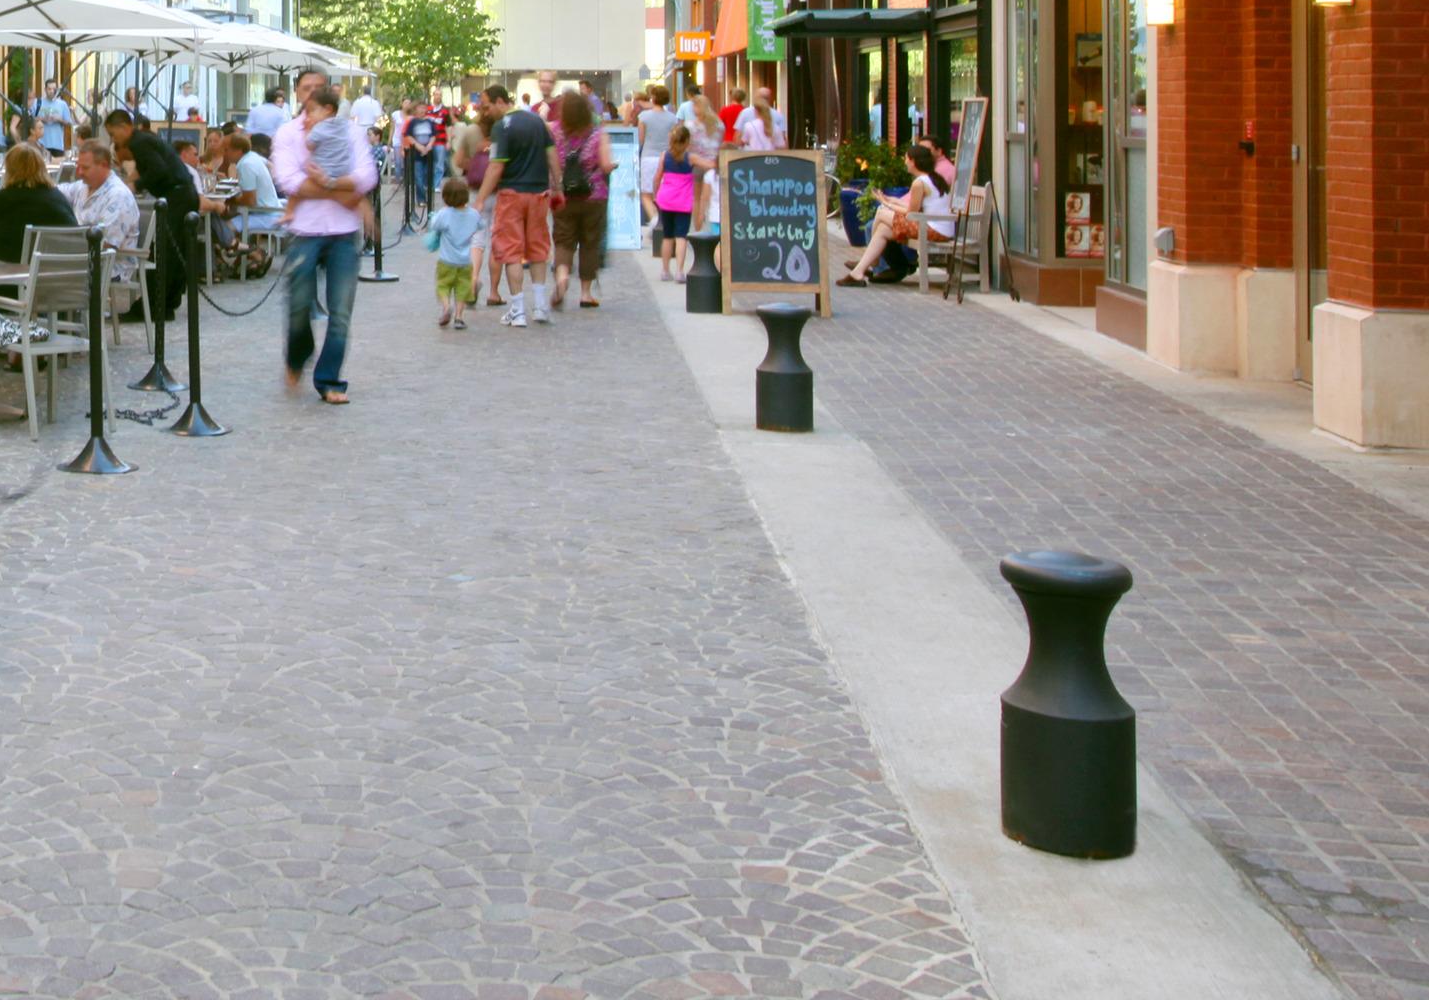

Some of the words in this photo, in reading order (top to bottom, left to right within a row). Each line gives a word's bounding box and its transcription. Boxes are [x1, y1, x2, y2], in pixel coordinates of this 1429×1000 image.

[679, 36, 706, 55] lucy
[748, 197, 817, 227] Blowdry
[733, 221, 815, 250] Starting
[761, 240, 811, 283] 20
